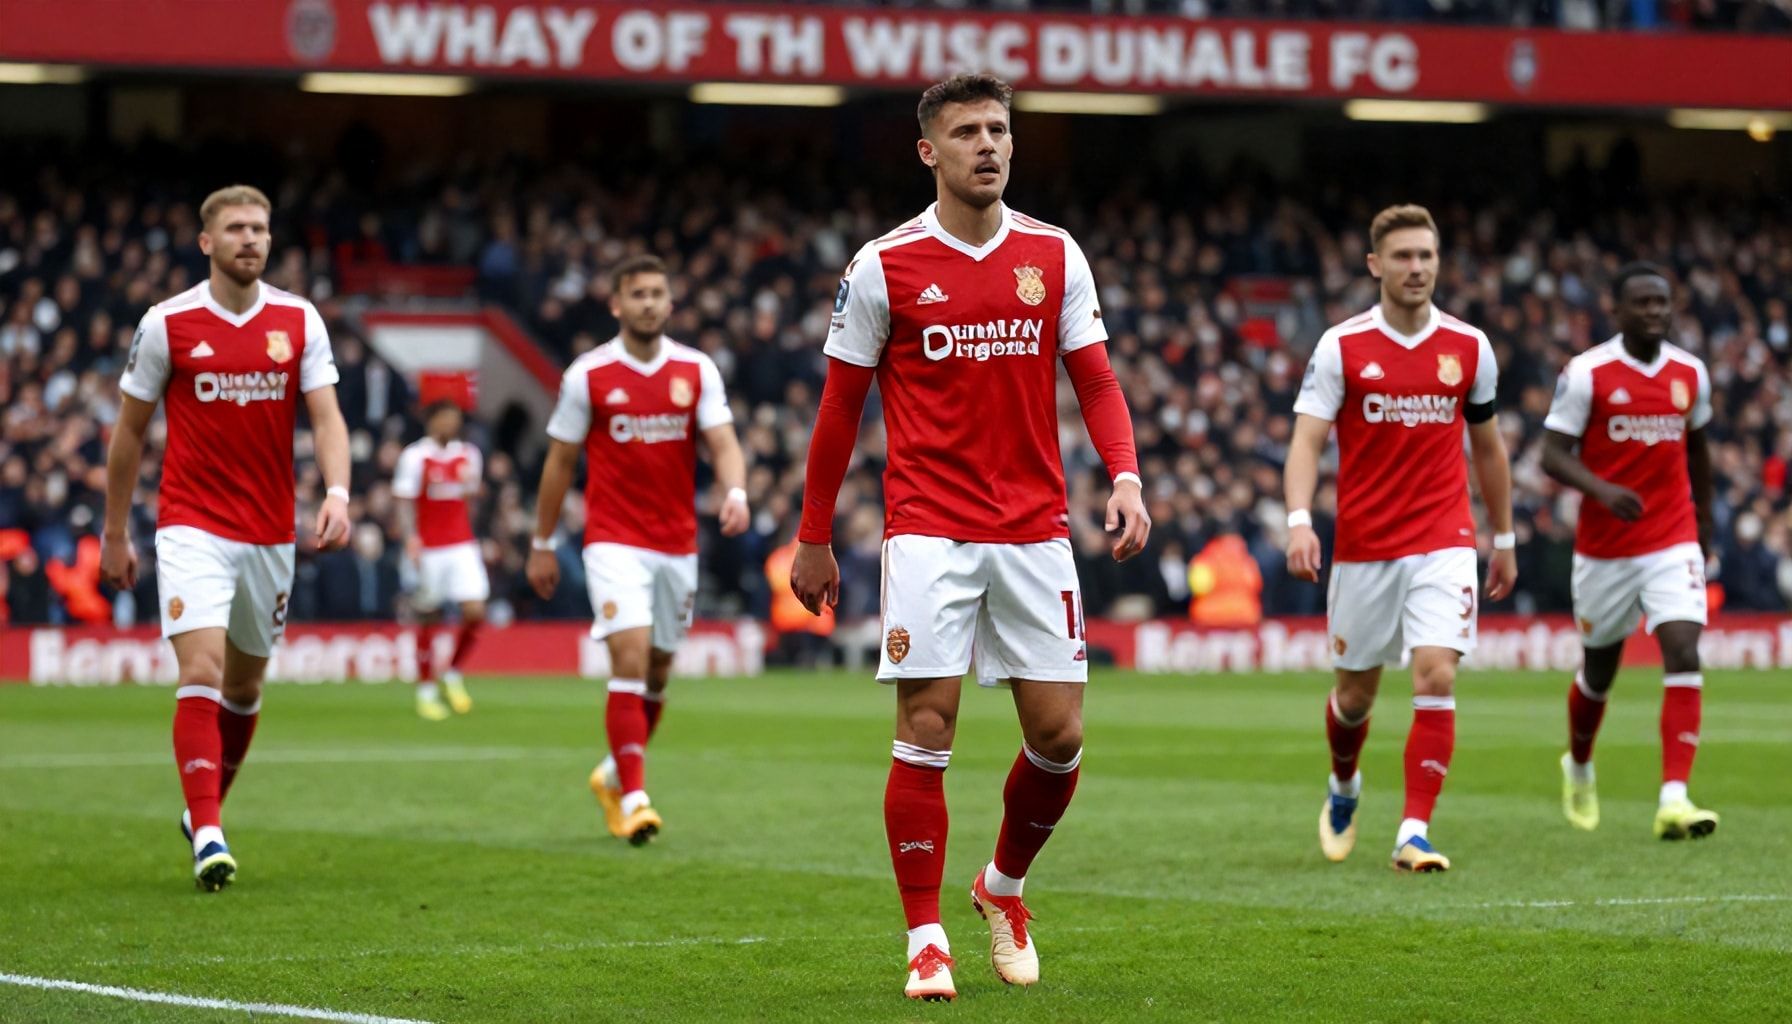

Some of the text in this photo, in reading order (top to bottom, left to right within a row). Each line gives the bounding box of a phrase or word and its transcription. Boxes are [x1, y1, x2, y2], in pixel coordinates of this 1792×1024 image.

[369, 4, 597, 69] WHAY
[612, 10, 709, 72] OF
[724, 13, 825, 76] TH
[1329, 31, 1419, 92] FC
